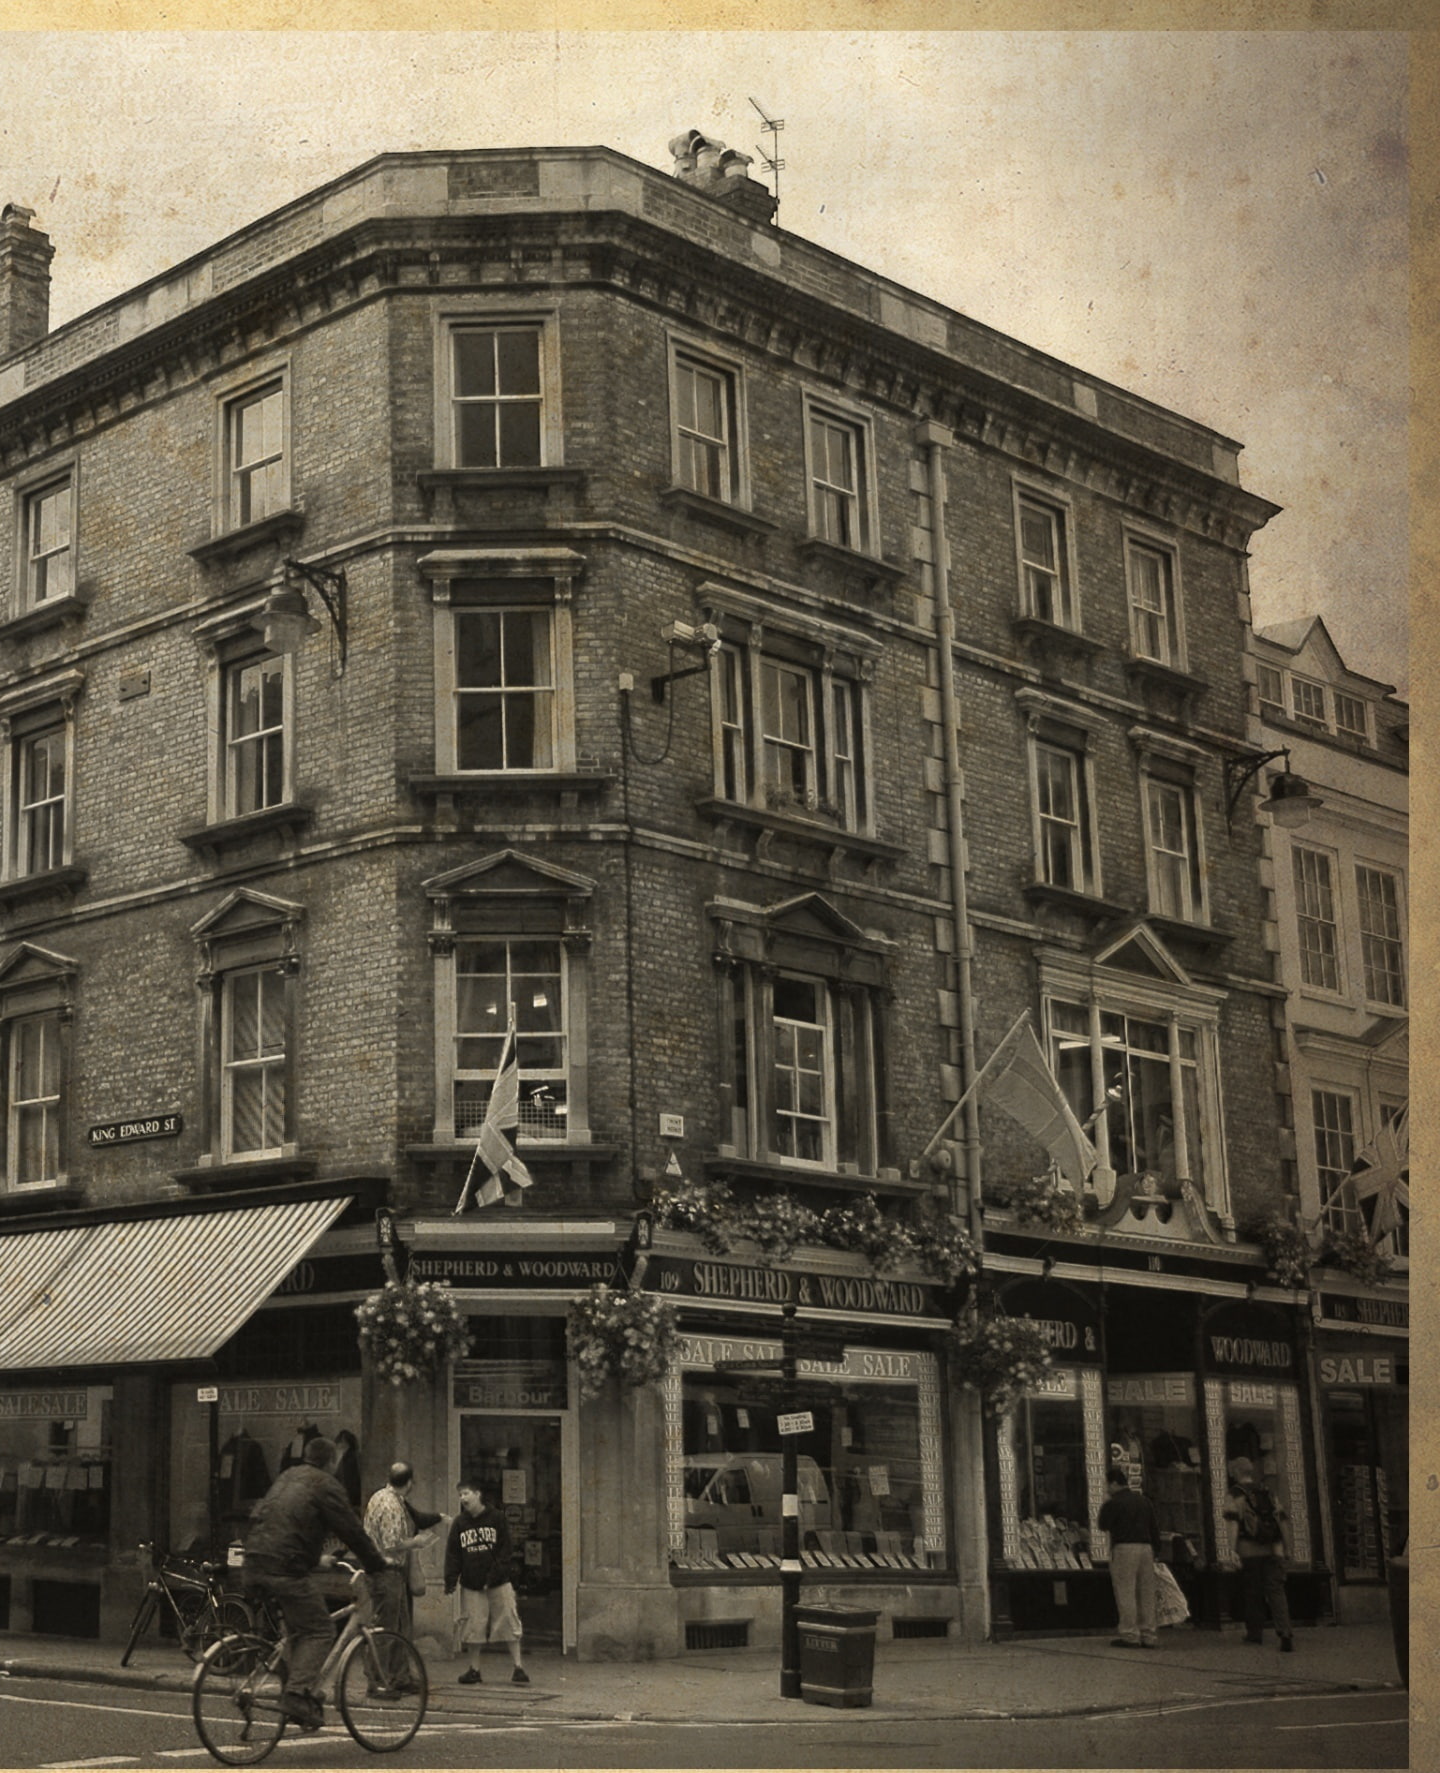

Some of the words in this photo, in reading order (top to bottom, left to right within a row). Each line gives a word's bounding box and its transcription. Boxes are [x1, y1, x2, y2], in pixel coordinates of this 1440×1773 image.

[92, 1128, 115, 1142] KING
[120, 1120, 160, 1137] EDWARD
[164, 1119, 175, 1130] ST
[412, 1260, 498, 1276] SHEPHERD
[503, 1262, 514, 1277] &
[518, 1261, 615, 1278] WOODWARD
[660, 1271, 680, 1290] 109
[693, 1262, 791, 1300] SHEPHERD
[799, 1277, 811, 1304] &
[818, 1276, 924, 1313] WOODWARD
[1085, 1326, 1096, 1351] &
[680, 1338, 734, 1364] SALE
[743, 1344, 779, 1361] SAL
[863, 1354, 911, 1377] SALE
[1210, 1335, 1292, 1368] WOODWARD
[1320, 1358, 1391, 1384] SALE
[220, 1388, 261, 1412] ALE
[275, 1386, 331, 1411] SALE
[469, 1385, 552, 1405] Barbour
[1107, 1379, 1186, 1401] SALE
[1231, 1382, 1274, 1405] SALE
[40, 1394, 87, 1416] SALE
